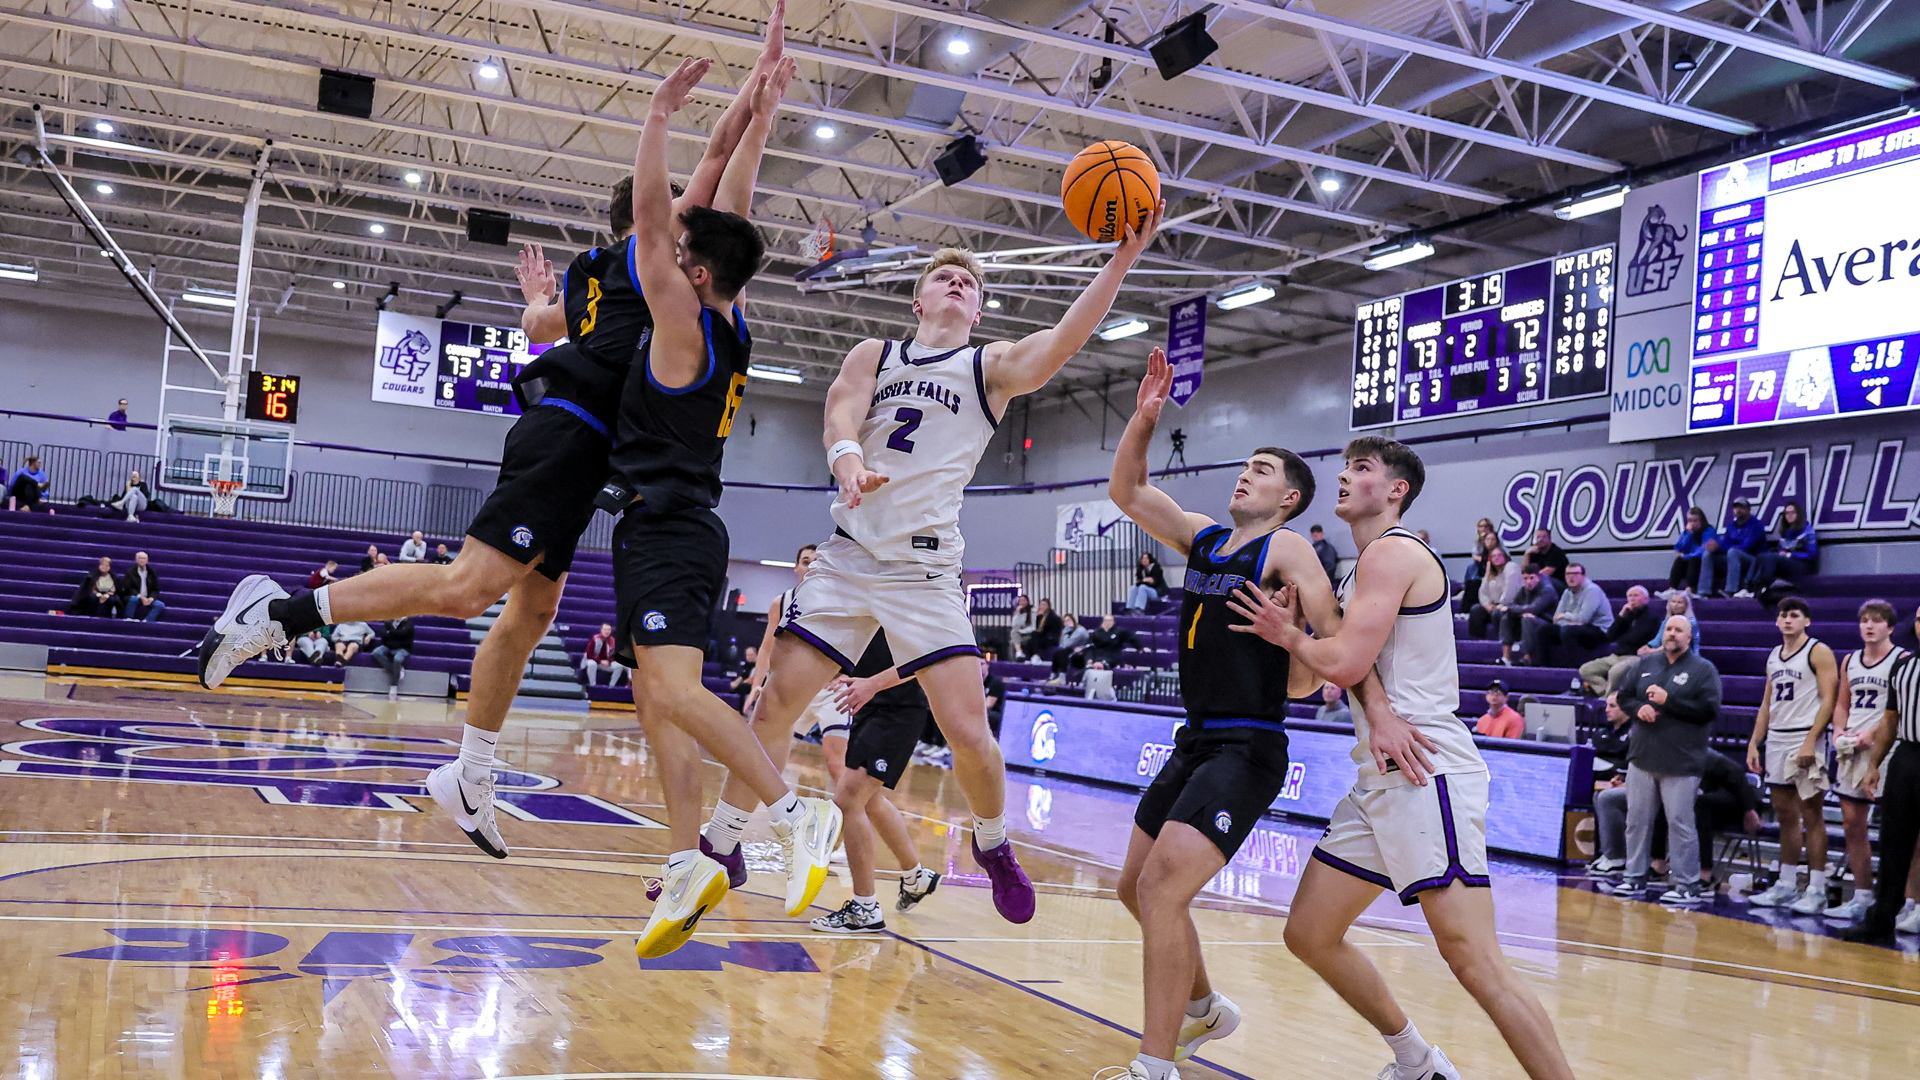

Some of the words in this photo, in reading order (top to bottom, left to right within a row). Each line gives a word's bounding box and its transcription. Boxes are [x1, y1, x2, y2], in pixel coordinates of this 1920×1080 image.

[1771, 148, 1835, 182] WELCOME
[1836, 143, 1855, 166] TO
[1856, 135, 1885, 161] THE
[1591, 247, 1612, 267] PTS
[1595, 266, 1610, 285] 12
[1625, 254, 1684, 298] USF
[580, 278, 602, 336] 3
[1564, 294, 1574, 313] 3
[1581, 292, 1587, 308] 1
[1599, 287, 1609, 304] 9
[1460, 319, 1483, 333] PERIOD
[1562, 316, 1573, 332] 4
[1575, 312, 1586, 331] 0
[1597, 307, 1608, 327] 0
[1372, 335, 1382, 352] 2
[1464, 334, 1477, 358] 2
[1513, 318, 1540, 350] 72
[1557, 335, 1572, 354] 12
[1592, 328, 1607, 348] 12
[380, 345, 431, 382] USF
[486, 354, 508, 363] PERIOD
[1414, 339, 1437, 368] 73
[1519, 351, 1540, 364] FOULS
[1556, 355, 1570, 374] 15
[1850, 340, 1905, 373] 3:15
[448, 355, 472, 378] 73
[490, 362, 502, 380] 2
[1450, 362, 1473, 377] PLAYER
[1474, 360, 1490, 372] FOUL
[1525, 362, 1537, 387] 5
[262, 375, 297, 393] 3:14
[382, 382, 425, 394] COUGARS
[438, 375, 458, 384] FOULS
[443, 382, 454, 399] 6
[476, 379, 498, 389] PLAYER
[1430, 379, 1441, 403] 3
[1498, 367, 1509, 392] 3
[1746, 370, 1777, 402] 73
[266, 392, 288, 418] 16
[436, 399, 456, 407] SCORE
[917, 381, 961, 415] FALLS
[1409, 382, 1420, 406] 6
[1456, 399, 1478, 412] MATCH
[1516, 389, 1538, 403] SCORE
[1613, 383, 1682, 413] MIDCO
[482, 404, 503, 413] MATCH
[886, 407, 923, 454] 2
[1499, 454, 1717, 547] SIOUX
[1717, 439, 1920, 535] FALL
[1188, 603, 1203, 649] 1
[1776, 682, 1794, 702] 23
[1855, 689, 1878, 709] 22
